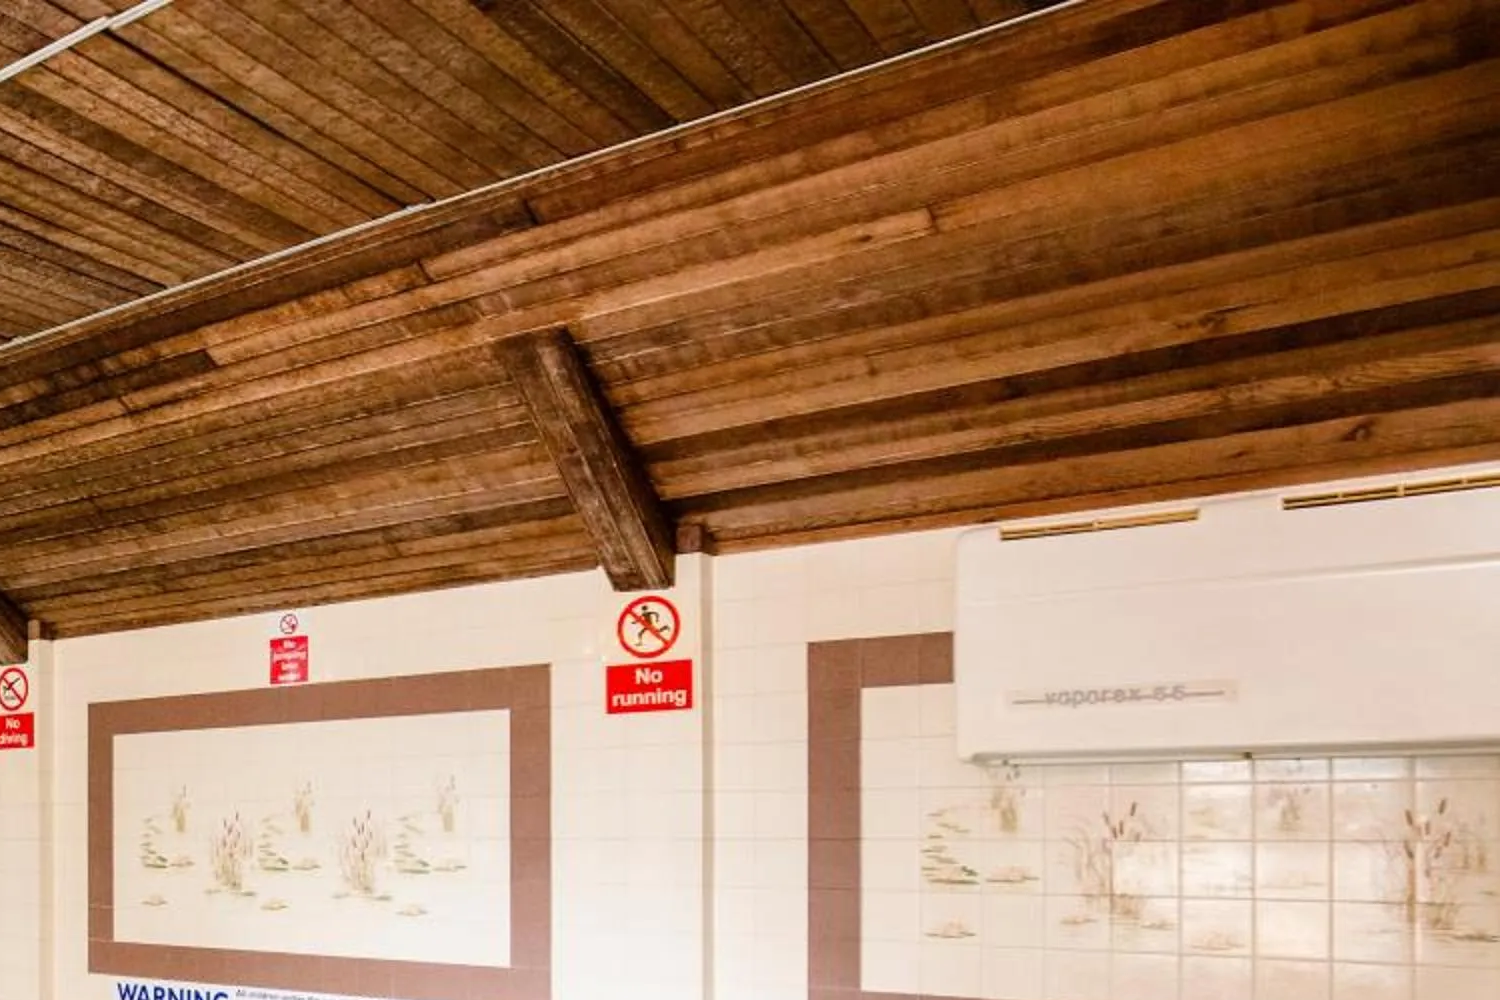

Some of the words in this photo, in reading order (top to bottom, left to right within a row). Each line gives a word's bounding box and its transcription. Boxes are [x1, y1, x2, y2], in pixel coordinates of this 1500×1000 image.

[635, 667, 663, 685] No
[611, 687, 688, 707] running
[1044, 687, 1142, 708] vaporex
[5, 717, 21, 729] No
